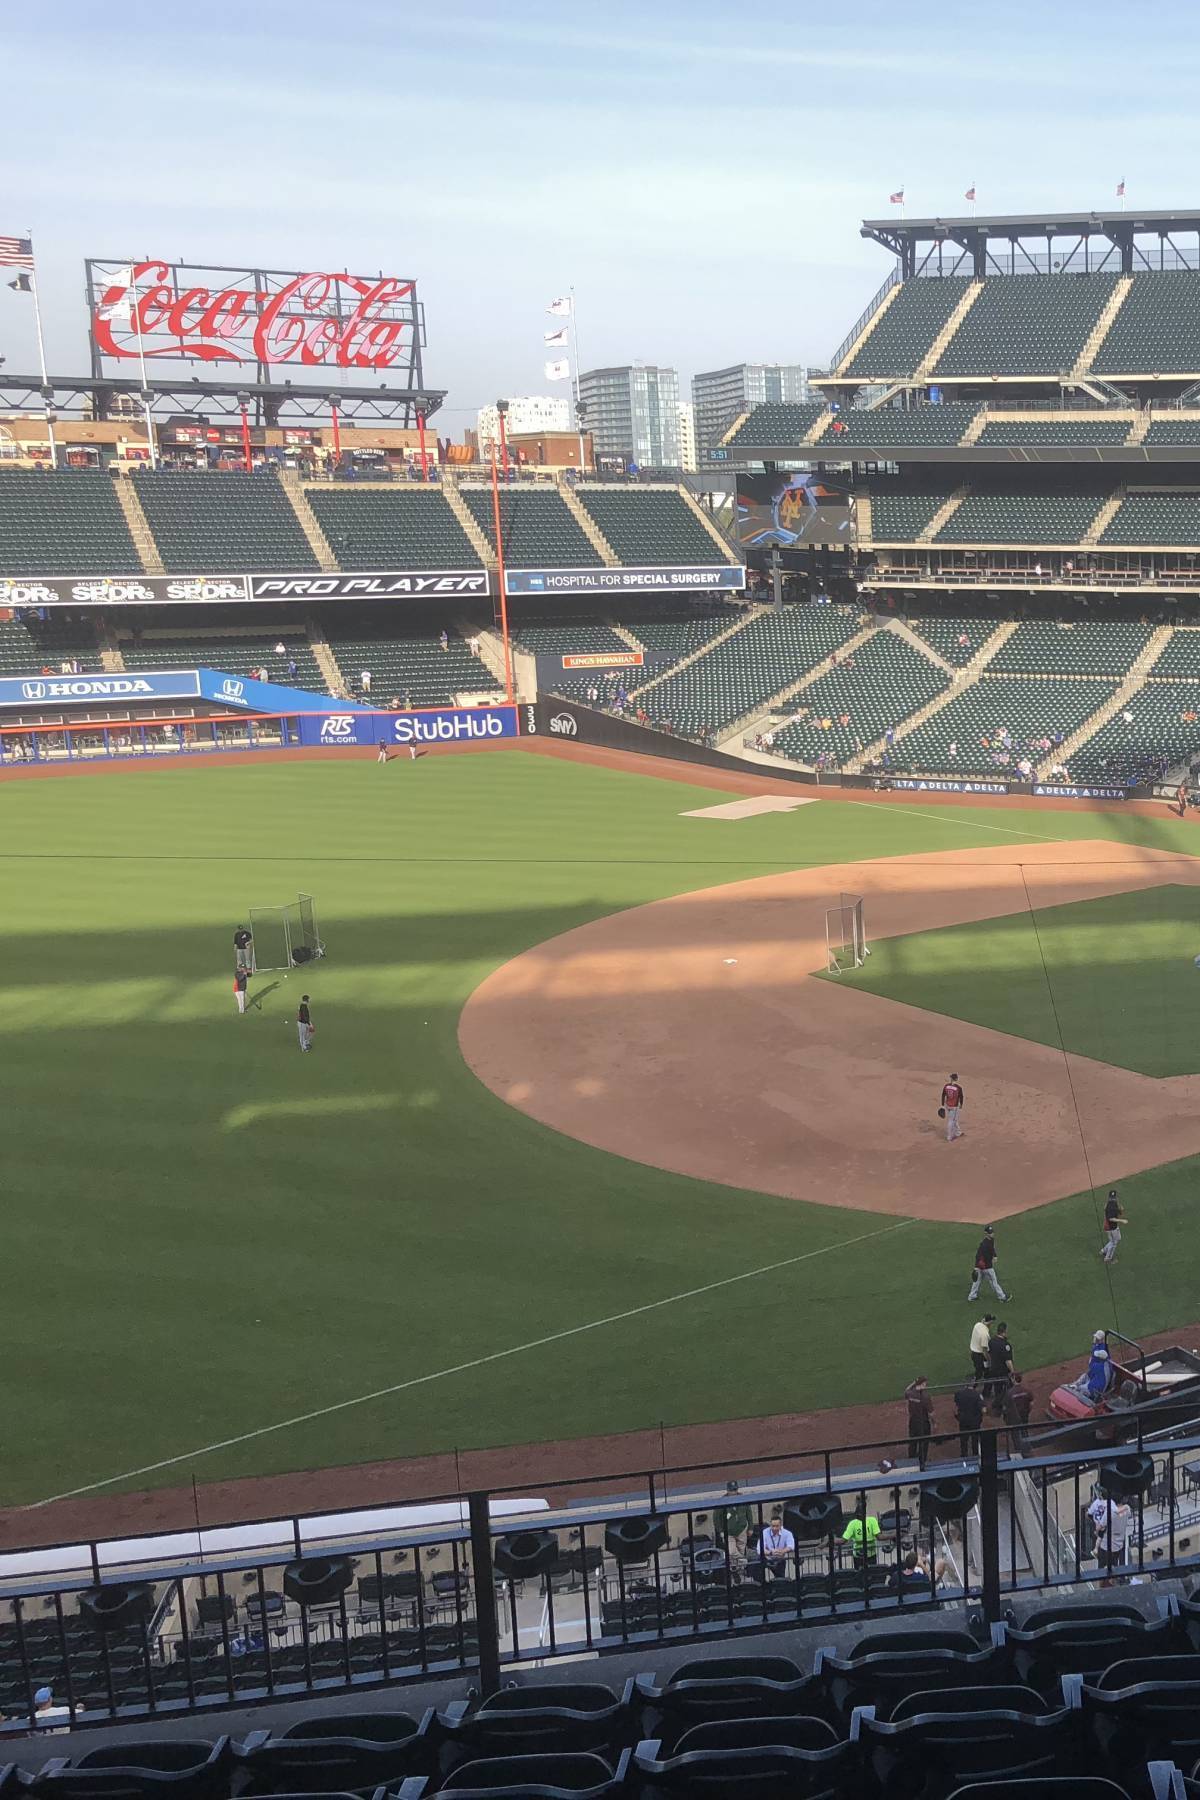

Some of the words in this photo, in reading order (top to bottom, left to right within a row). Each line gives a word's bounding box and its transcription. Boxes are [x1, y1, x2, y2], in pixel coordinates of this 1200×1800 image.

[711, 450, 728, 459] 5:51
[255, 580, 340, 594] PRO
[341, 577, 485, 593] PLAYER
[546, 575, 598, 586] HOSPITAL
[601, 575, 621, 585] FOR
[623, 575, 669, 584] SPECIAL
[671, 574, 721, 583] SURGERY
[48, 680, 154, 696] HONDA
[214, 693, 249, 705] HONDA
[321, 716, 355, 735] RTS
[394, 713, 503, 741] StubHub
[550, 716, 575, 734] SNY
[320, 735, 357, 743] rts.com
[929, 782, 960, 790] DELTA
[974, 784, 1006, 792] DELTA
[1046, 787, 1078, 795] DELTA
[1092, 789, 1124, 797] DELTA
